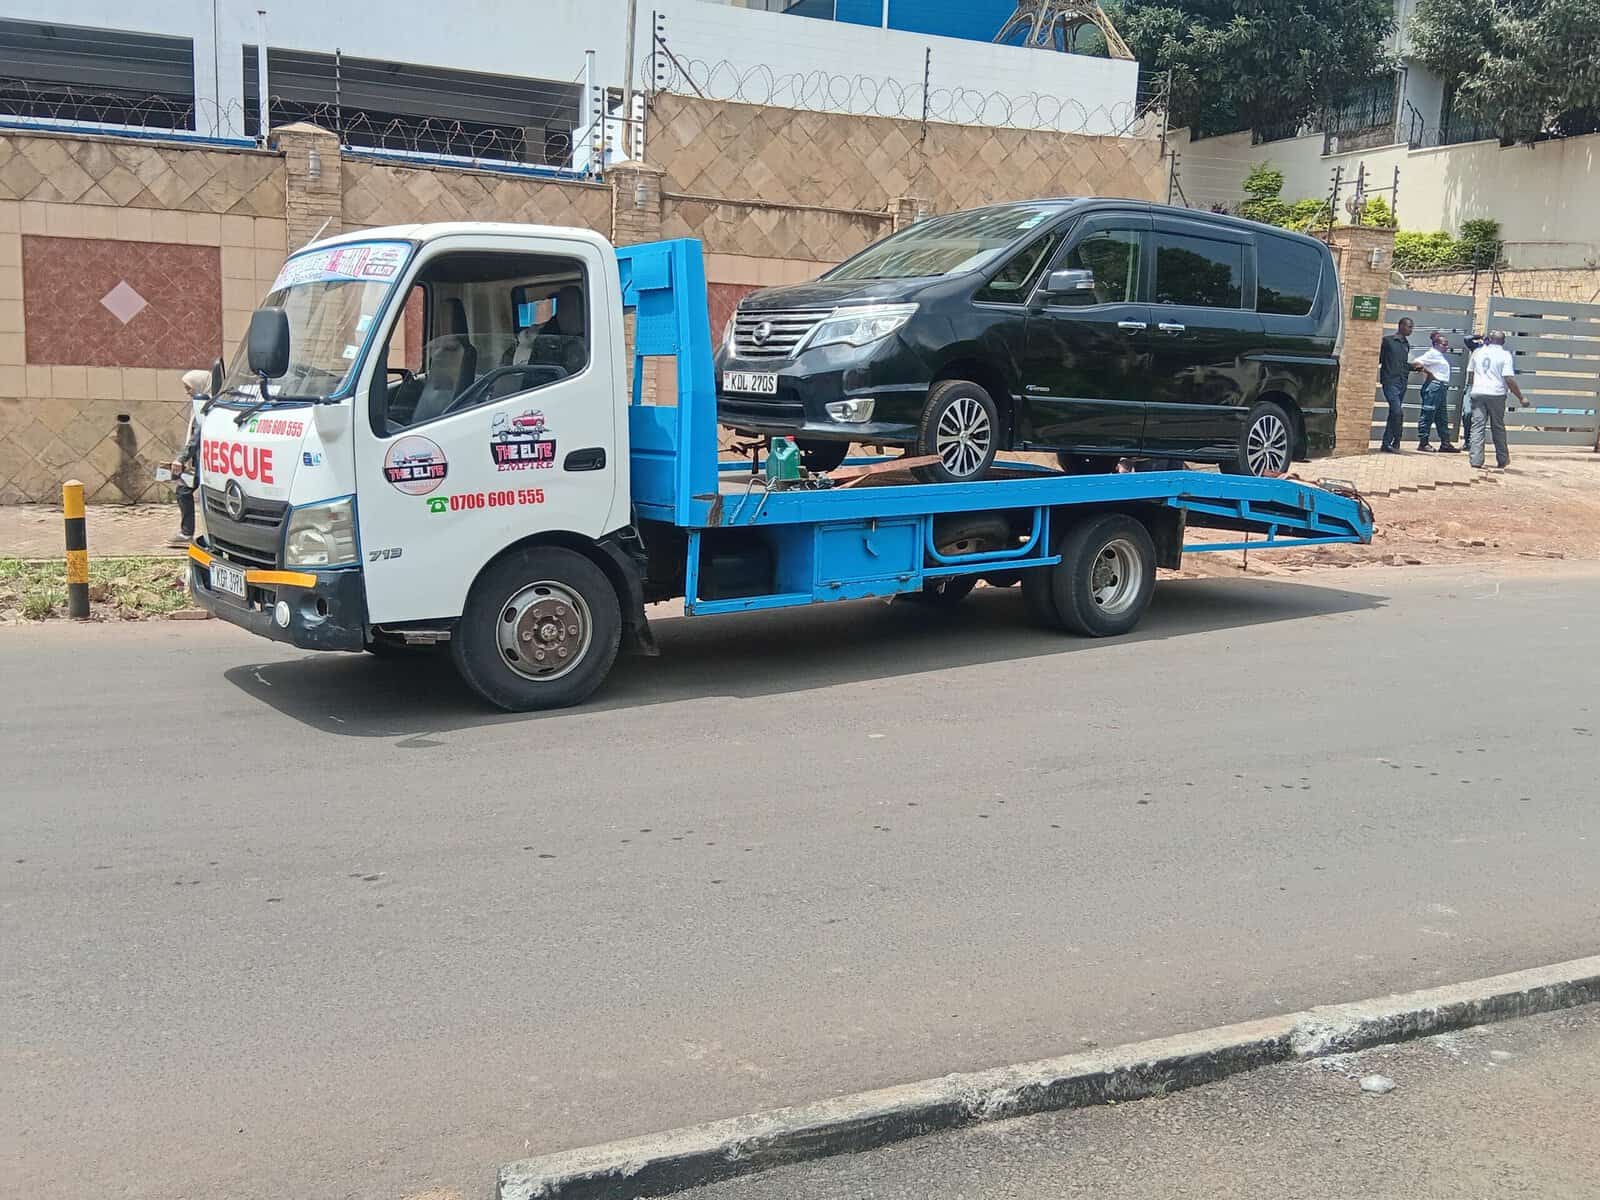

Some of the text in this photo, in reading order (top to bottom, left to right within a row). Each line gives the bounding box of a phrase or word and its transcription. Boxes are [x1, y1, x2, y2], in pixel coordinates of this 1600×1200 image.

[732, 374, 774, 392] KDL 270S
[286, 421, 304, 437] 555
[496, 442, 553, 462] THE ELITE
[203, 439, 274, 484] RESCUE
[497, 461, 554, 472] EMPIRE
[389, 464, 445, 481] THE ELITE
[450, 488, 545, 511] 0706 600 555
[368, 547, 402, 562] 713
